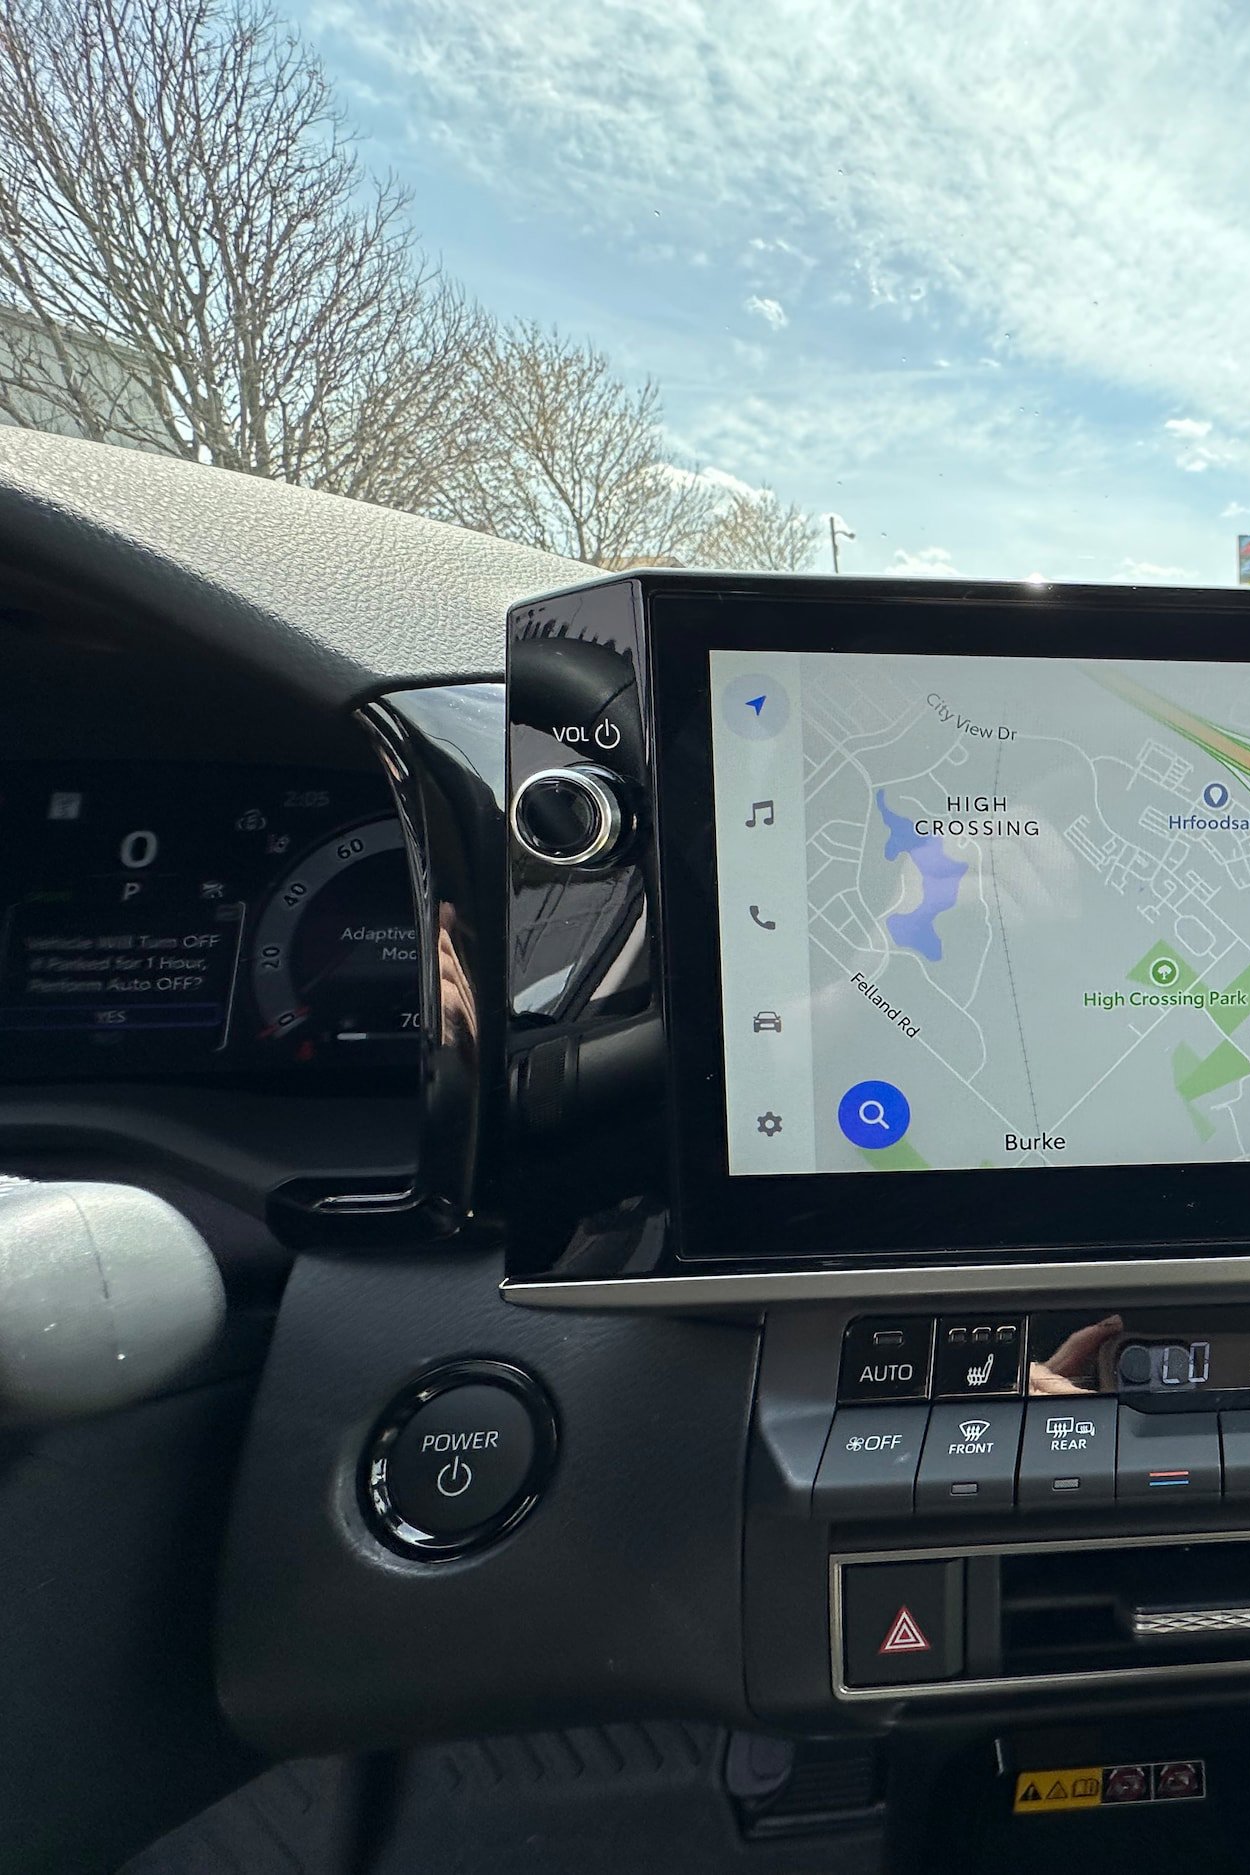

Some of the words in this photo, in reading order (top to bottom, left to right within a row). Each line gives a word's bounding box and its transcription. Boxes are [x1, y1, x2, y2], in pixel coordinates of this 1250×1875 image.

[926, 692, 954, 722] City
[955, 715, 993, 739] View
[998, 726, 1018, 741] Dr
[552, 726, 589, 743] VOL
[947, 796, 1008, 813] HIGH
[914, 819, 1040, 836] CROSSING
[120, 830, 159, 869] 0
[336, 837, 364, 860] 60
[123, 882, 142, 901] P
[283, 882, 308, 908] 40
[183, 934, 221, 948] OFF
[850, 972, 902, 1020] Felland
[897, 1016, 921, 1038] Rd
[1083, 991, 1126, 1012] High
[1129, 991, 1206, 1011] Crossing
[1210, 990, 1247, 1007] Park
[1004, 1133, 1066, 1151] Burke
[859, 1363, 914, 1383] AUTO
[421, 1430, 500, 1453] POWER
[864, 1433, 903, 1451] OFF
[948, 1441, 994, 1455] FRONT
[1051, 1437, 1087, 1451] REAR
